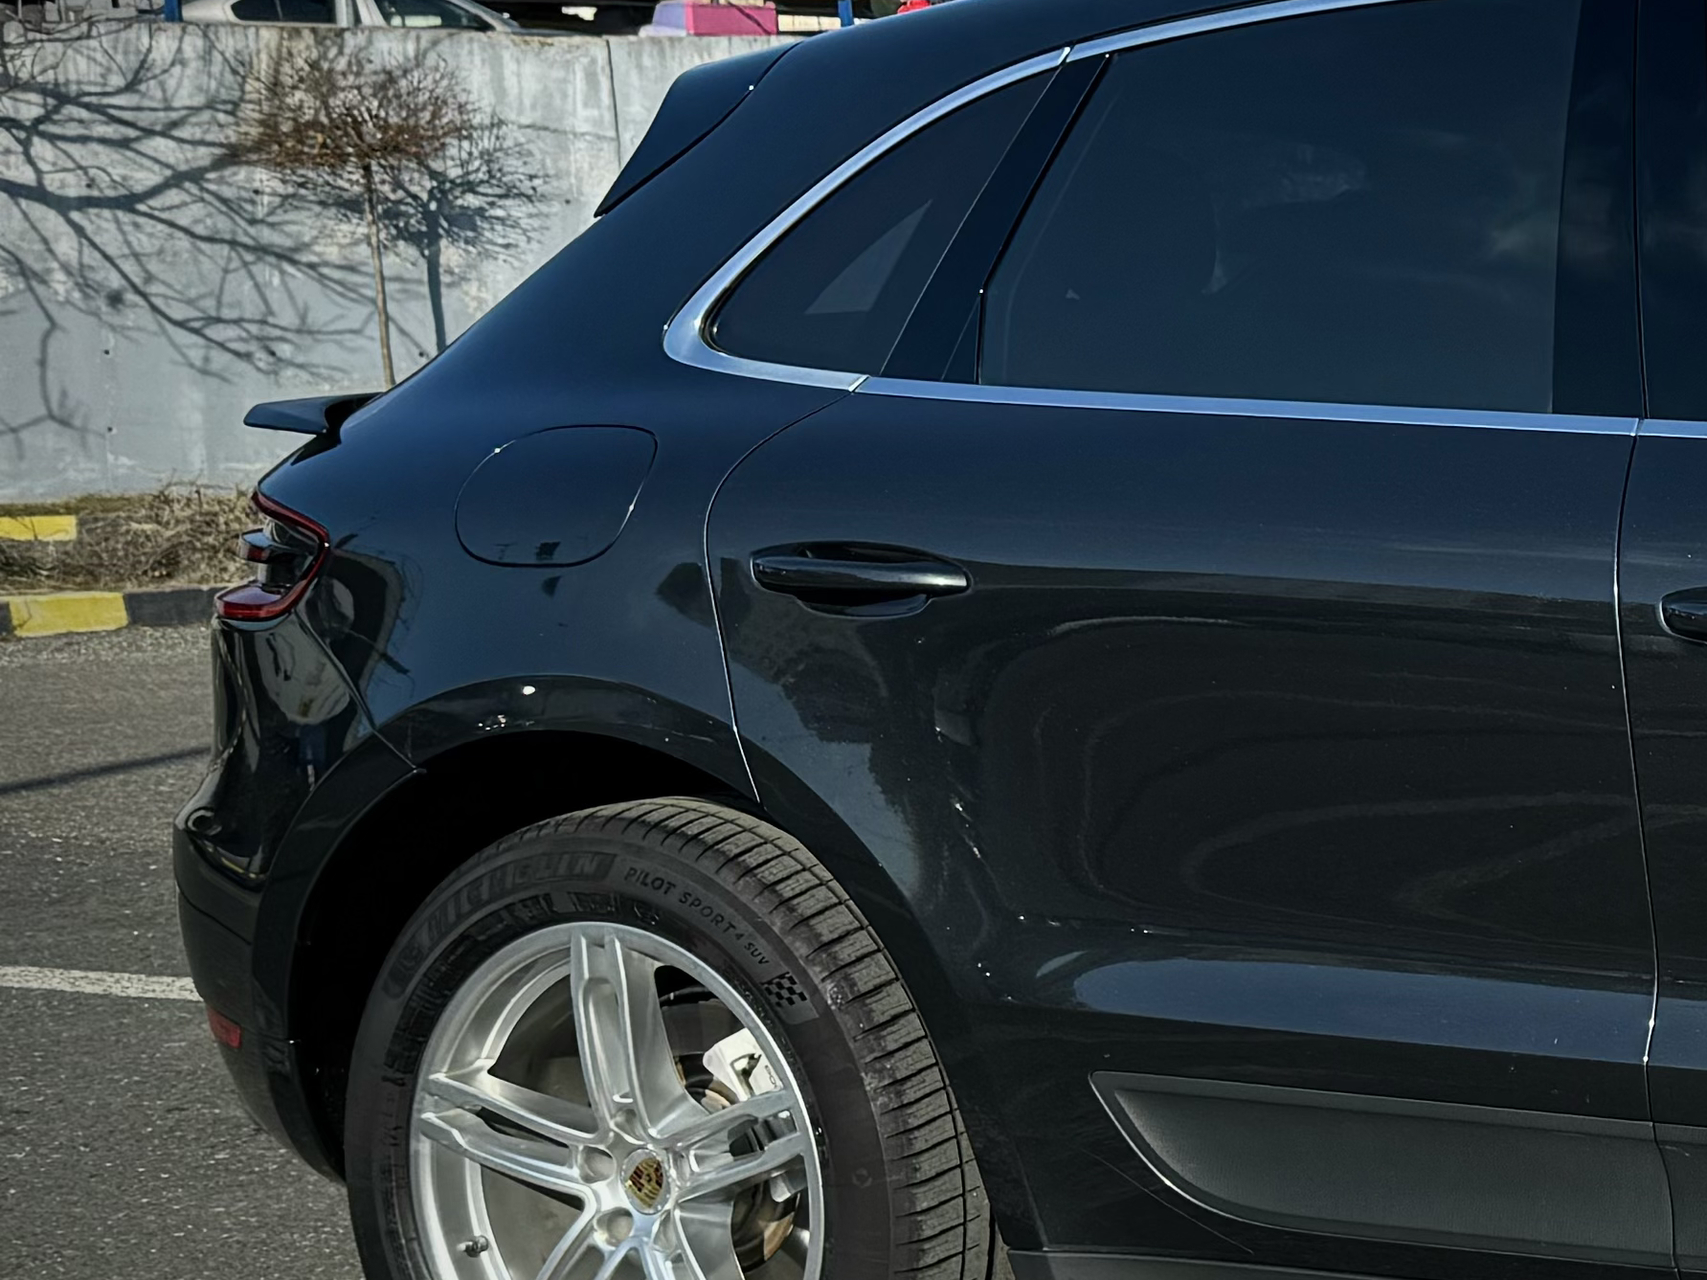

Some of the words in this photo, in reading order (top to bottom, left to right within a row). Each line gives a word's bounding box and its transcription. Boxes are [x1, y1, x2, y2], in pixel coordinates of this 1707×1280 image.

[624, 867, 676, 896] PILOT
[679, 891, 736, 934] SPORT
[735, 932, 745, 941] 4
[744, 942, 770, 965] SUV
